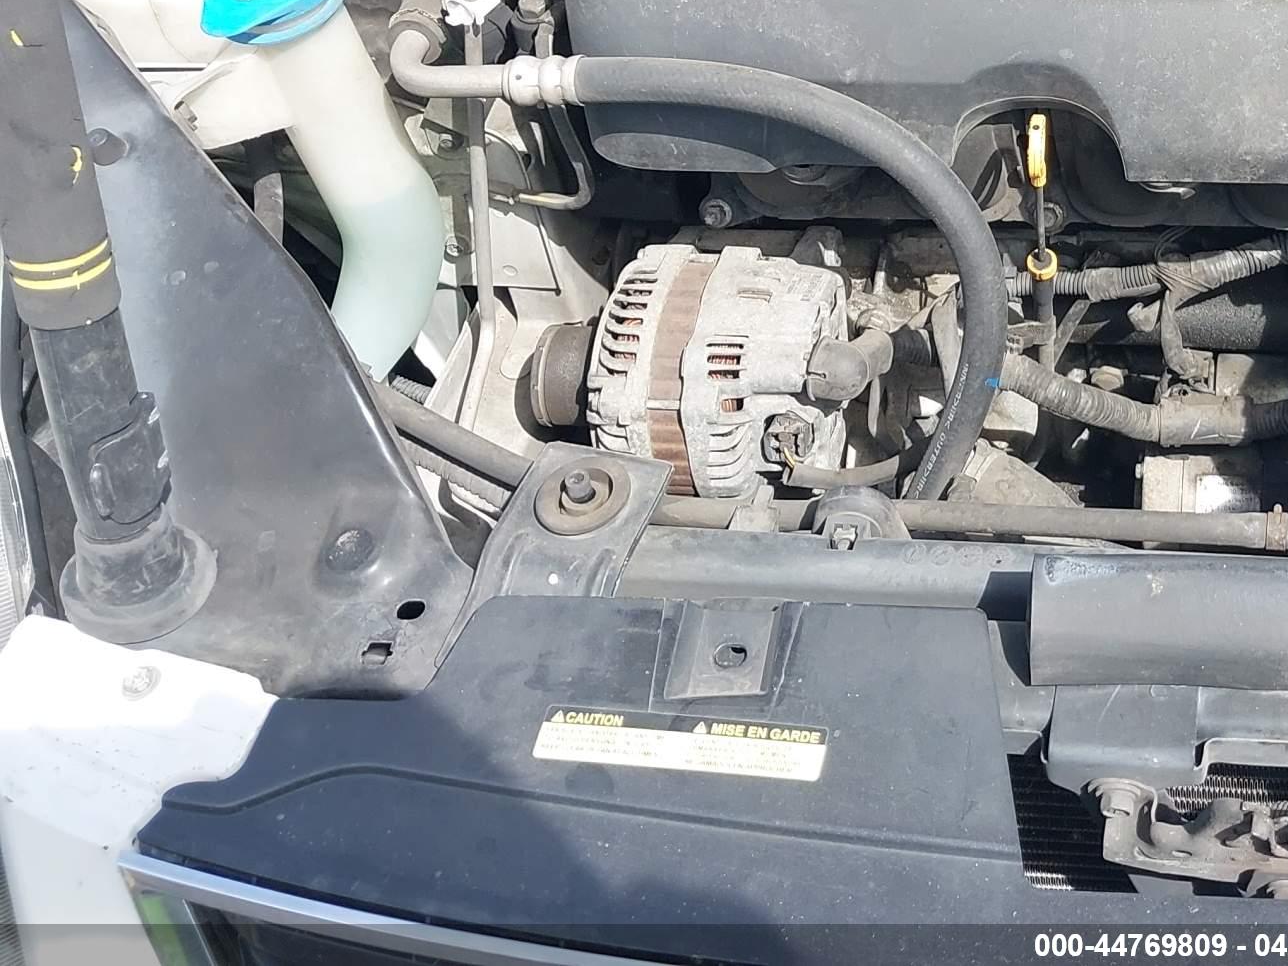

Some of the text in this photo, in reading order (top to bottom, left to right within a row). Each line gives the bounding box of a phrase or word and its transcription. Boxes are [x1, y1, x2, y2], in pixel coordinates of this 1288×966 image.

[565, 711, 624, 727] CAUTION
[710, 722, 821, 744] MISE EN GARDE
